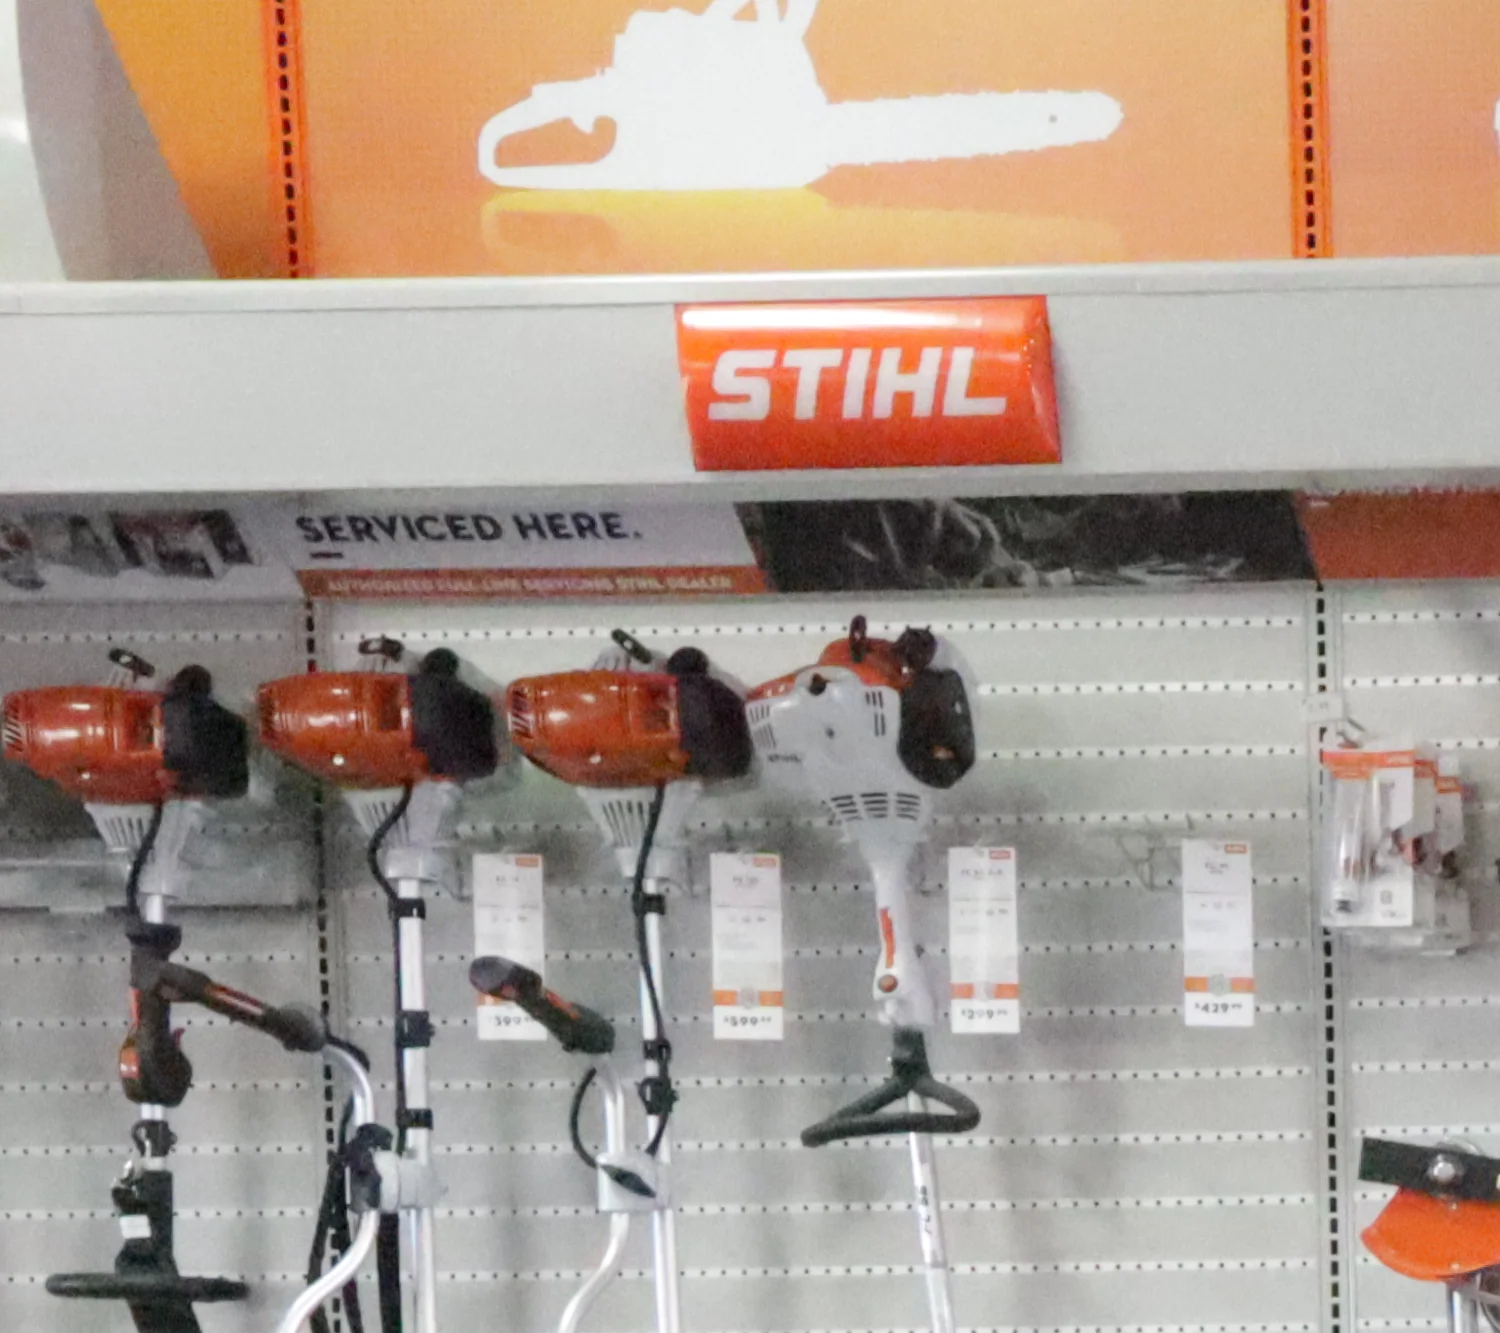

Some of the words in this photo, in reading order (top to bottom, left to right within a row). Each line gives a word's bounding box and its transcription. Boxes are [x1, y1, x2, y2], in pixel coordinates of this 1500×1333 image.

[708, 346, 1007, 421] STIHL
[296, 514, 502, 544] SERVICED
[516, 511, 642, 541] HERE.
